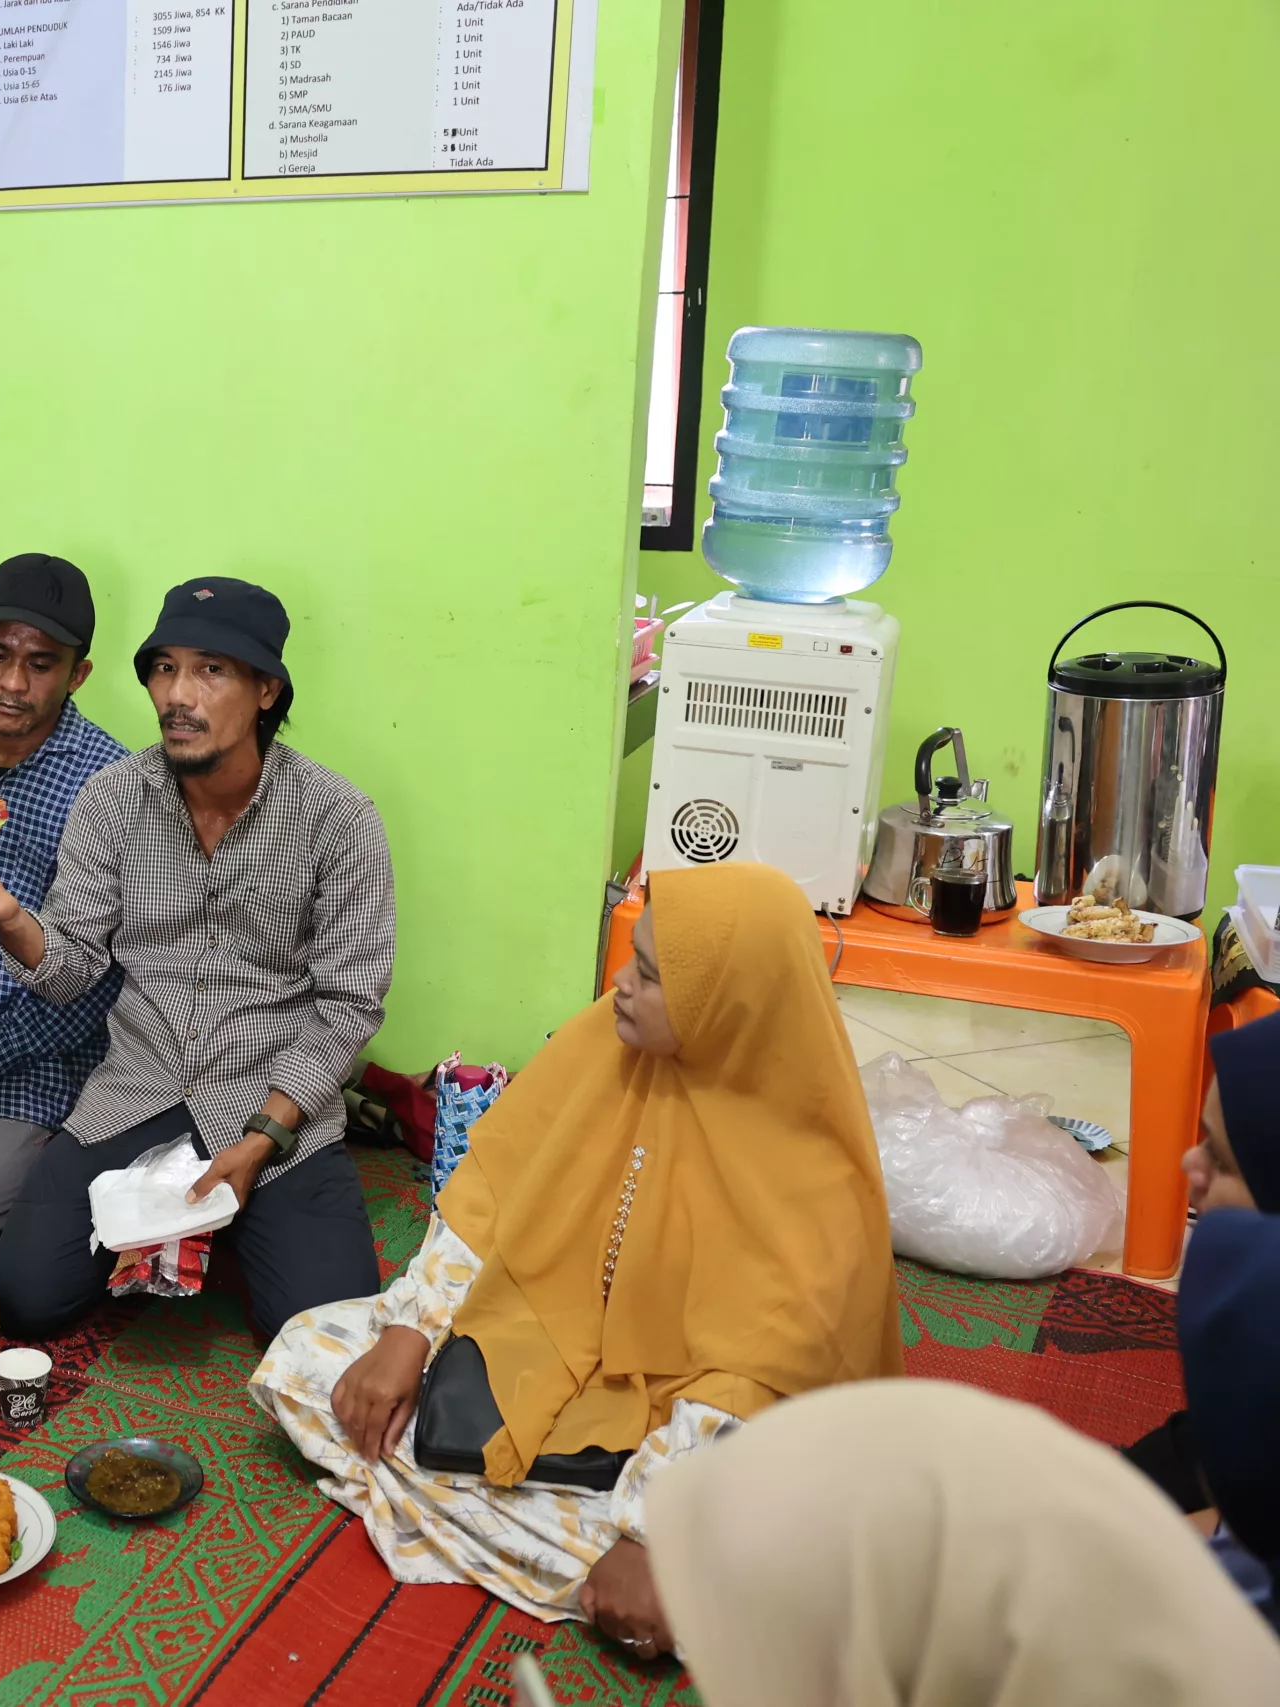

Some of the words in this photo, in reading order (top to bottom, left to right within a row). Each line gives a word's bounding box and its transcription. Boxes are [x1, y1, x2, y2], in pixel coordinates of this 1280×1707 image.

[281, 1, 310, 11] Sarana
[282, 15, 289, 26] 1)
[291, 15, 320, 25] Taman
[322, 12, 353, 22] Bacaan
[456, 0, 503, 12] Ada/Tidak
[505, 0, 524, 9] Ada
[27, 21, 68, 34] PENDUDUK
[153, 12, 172, 21] 3055
[174, 11, 194, 20] Jiwa,
[195, 8, 211, 18] 854
[215, 7, 226, 16] KK
[280, 31, 289, 41] 2)
[291, 29, 316, 39] PAUD
[456, 19, 462, 28] 1
[464, 17, 484, 28] Unit
[3, 40, 18, 49] Laki
[19, 39, 34, 48] Laki
[153, 26, 172, 35] 1509
[173, 25, 191, 34] Jiwa
[280, 46, 288, 56] 3)
[291, 45, 301, 54] TK
[456, 34, 461, 43] 1
[463, 33, 483, 43] Unit
[3, 52, 45, 64] Perempuan
[152, 41, 172, 50] 1546
[173, 40, 191, 49] Jiwa
[279, 61, 288, 71] 4)
[290, 60, 302, 70] SD
[455, 50, 460, 59] 1
[462, 49, 482, 59] Unit
[2, 68, 19, 77] Usia
[19, 66, 37, 76] 0-15
[156, 55, 171, 64] 734
[174, 54, 192, 63] Jiwa
[279, 76, 288, 86] 5)
[289, 73, 332, 84] Madrasah
[454, 66, 459, 75] 1
[462, 64, 482, 74] Unit
[3, 81, 19, 91] Usia
[21, 80, 40, 90] 15-65
[154, 69, 173, 78] 2145
[175, 69, 192, 77] Jiwa
[278, 91, 287, 101] 6)
[289, 90, 308, 100] SMP
[453, 81, 459, 91] 1
[461, 80, 481, 90] Unit
[3, 95, 19, 105] Usia
[20, 95, 29, 103] 65
[40, 92, 58, 102] Atas
[158, 84, 173, 93] 176
[174, 83, 192, 92] Jiwa
[278, 105, 287, 116] 7)
[288, 104, 332, 114] SMA/SMU
[452, 97, 458, 106] 1
[460, 96, 480, 106] Unit
[268, 121, 277, 130] d.
[278, 120, 307, 130] Sarana
[308, 118, 358, 129] Keagamaan
[279, 135, 288, 145] a)
[290, 133, 328, 144] Musholla
[459, 128, 479, 137] Unit
[279, 150, 288, 160] b)
[290, 148, 318, 159] Mesjid
[458, 142, 478, 152] Unit
[278, 164, 287, 174] c)
[288, 164, 316, 174] Gereja
[449, 158, 474, 167] Tidak
[476, 157, 494, 167] Ada
